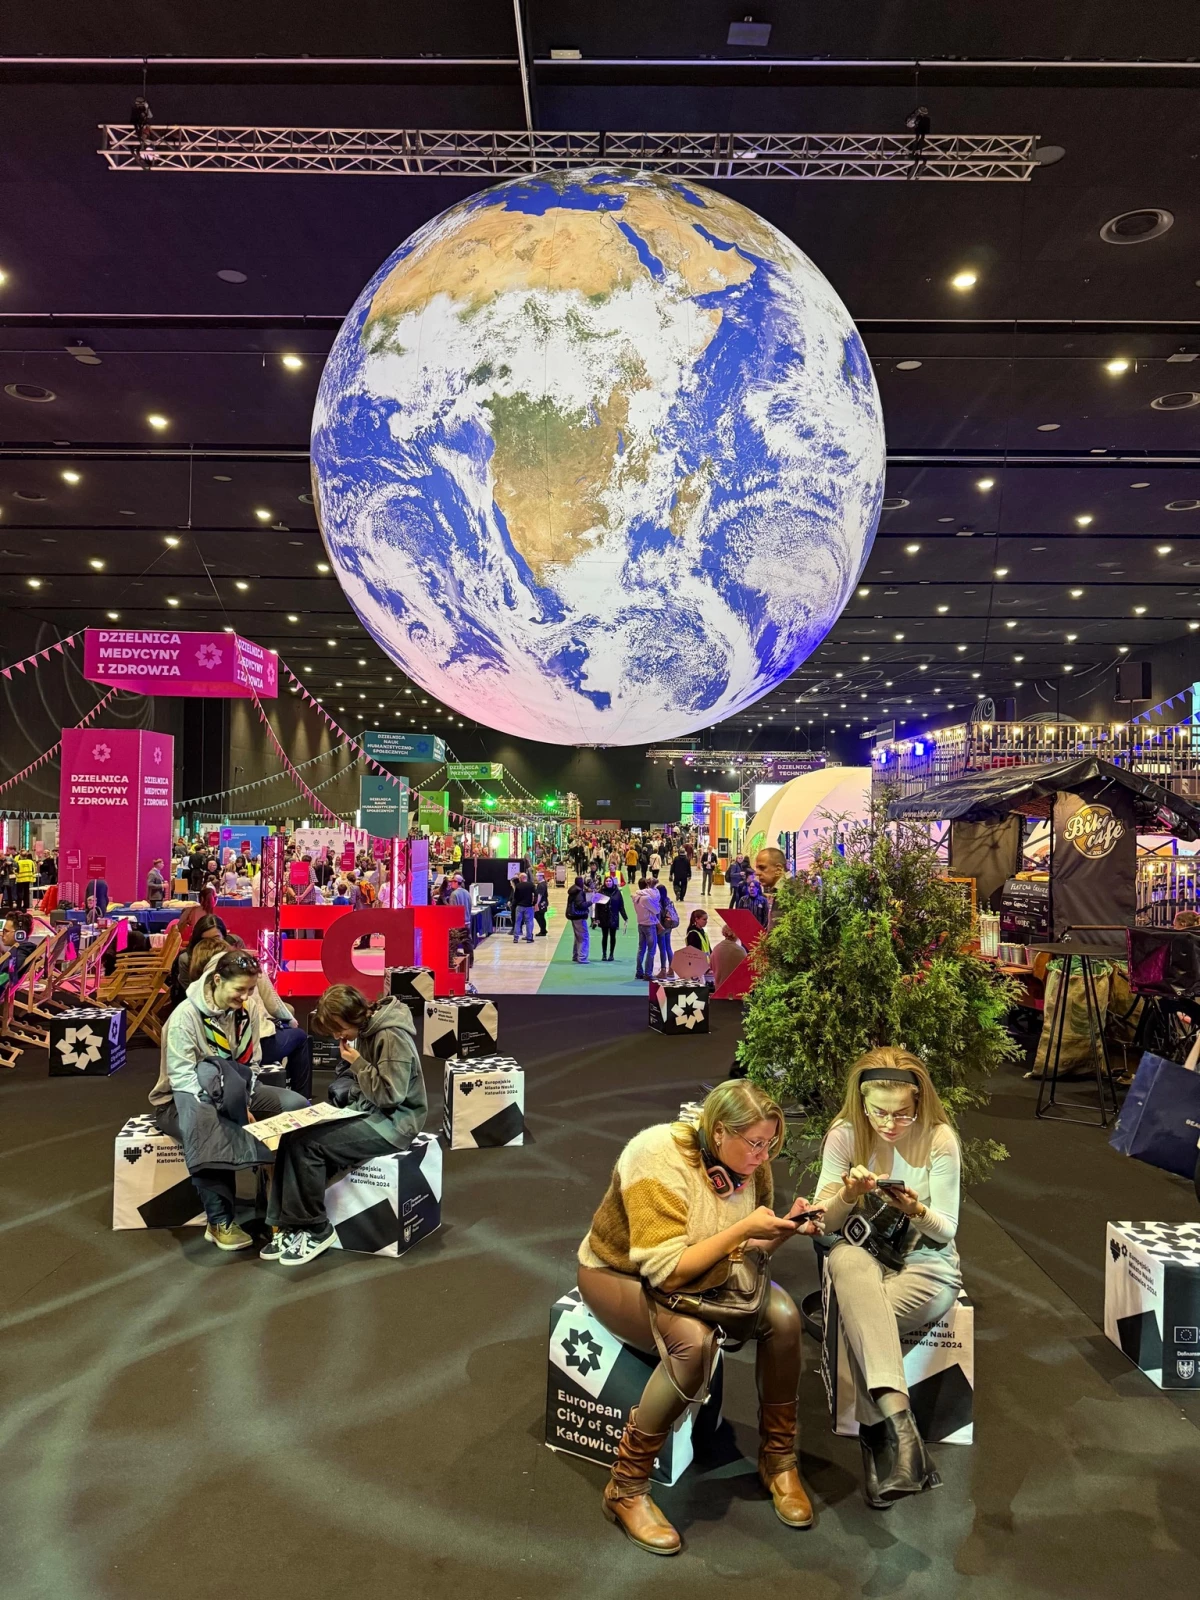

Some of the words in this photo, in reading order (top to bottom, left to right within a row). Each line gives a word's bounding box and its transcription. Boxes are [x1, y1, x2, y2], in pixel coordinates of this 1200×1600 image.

[99, 632, 181, 644] DZIELNICA
[100, 648, 180, 660] MEDYCYNY
[97, 664, 104, 674] I
[108, 664, 180, 676] ZDROWIA
[71, 774, 129, 783] DZIELNICA
[144, 776, 168, 785] DZIELNICA
[72, 786, 128, 794] MEDYCYNY
[144, 787, 168, 795] MEDYCYNY
[78, 797, 129, 806] ZDROWIA
[147, 798, 168, 806] ZDROWIA
[350, 1178, 375, 1186] Katowice
[1147, 1284, 1157, 1296] 2024
[900, 1338, 938, 1347] Katowice
[941, 1341, 962, 1349] 2024
[557, 1389, 622, 1419] European
[556, 1408, 584, 1428] City
[588, 1420, 602, 1432] of
[605, 1424, 627, 1439] Sci
[556, 1426, 620, 1456] Katowice
